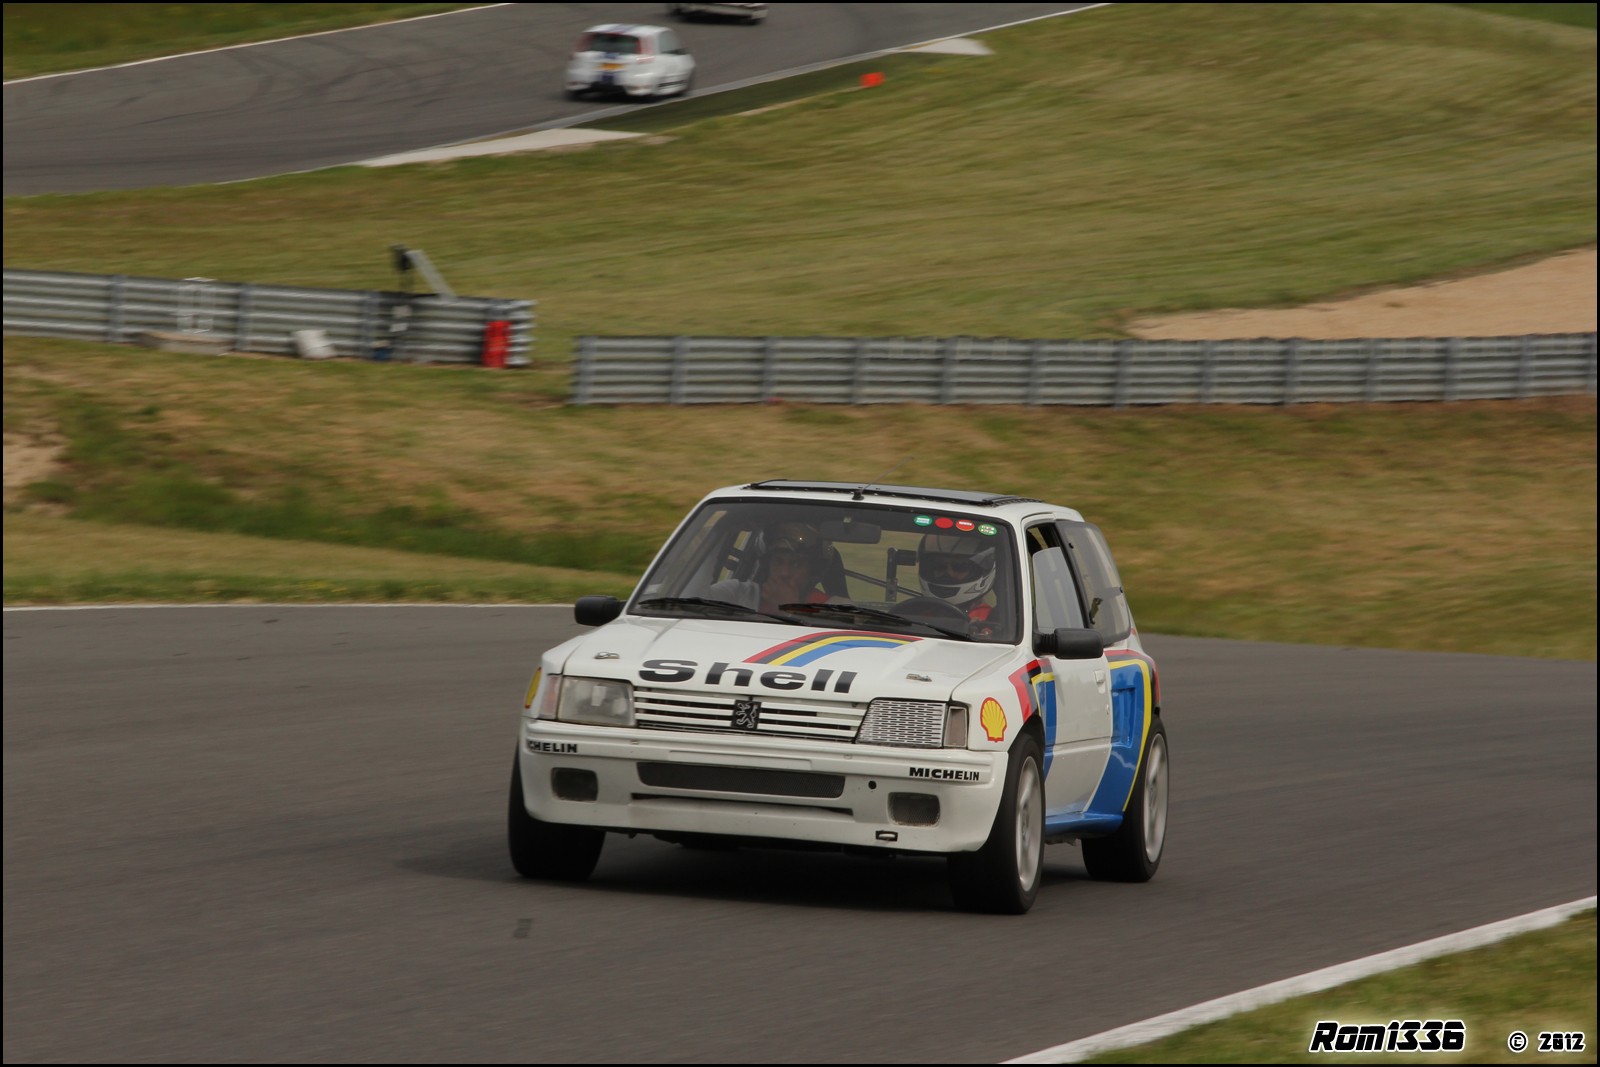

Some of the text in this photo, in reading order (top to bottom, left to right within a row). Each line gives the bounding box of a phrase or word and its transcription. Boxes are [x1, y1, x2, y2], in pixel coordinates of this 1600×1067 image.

[639, 659, 858, 694] Shell
[528, 740, 578, 753] CHELIN
[909, 766, 980, 781] MICHELIN
